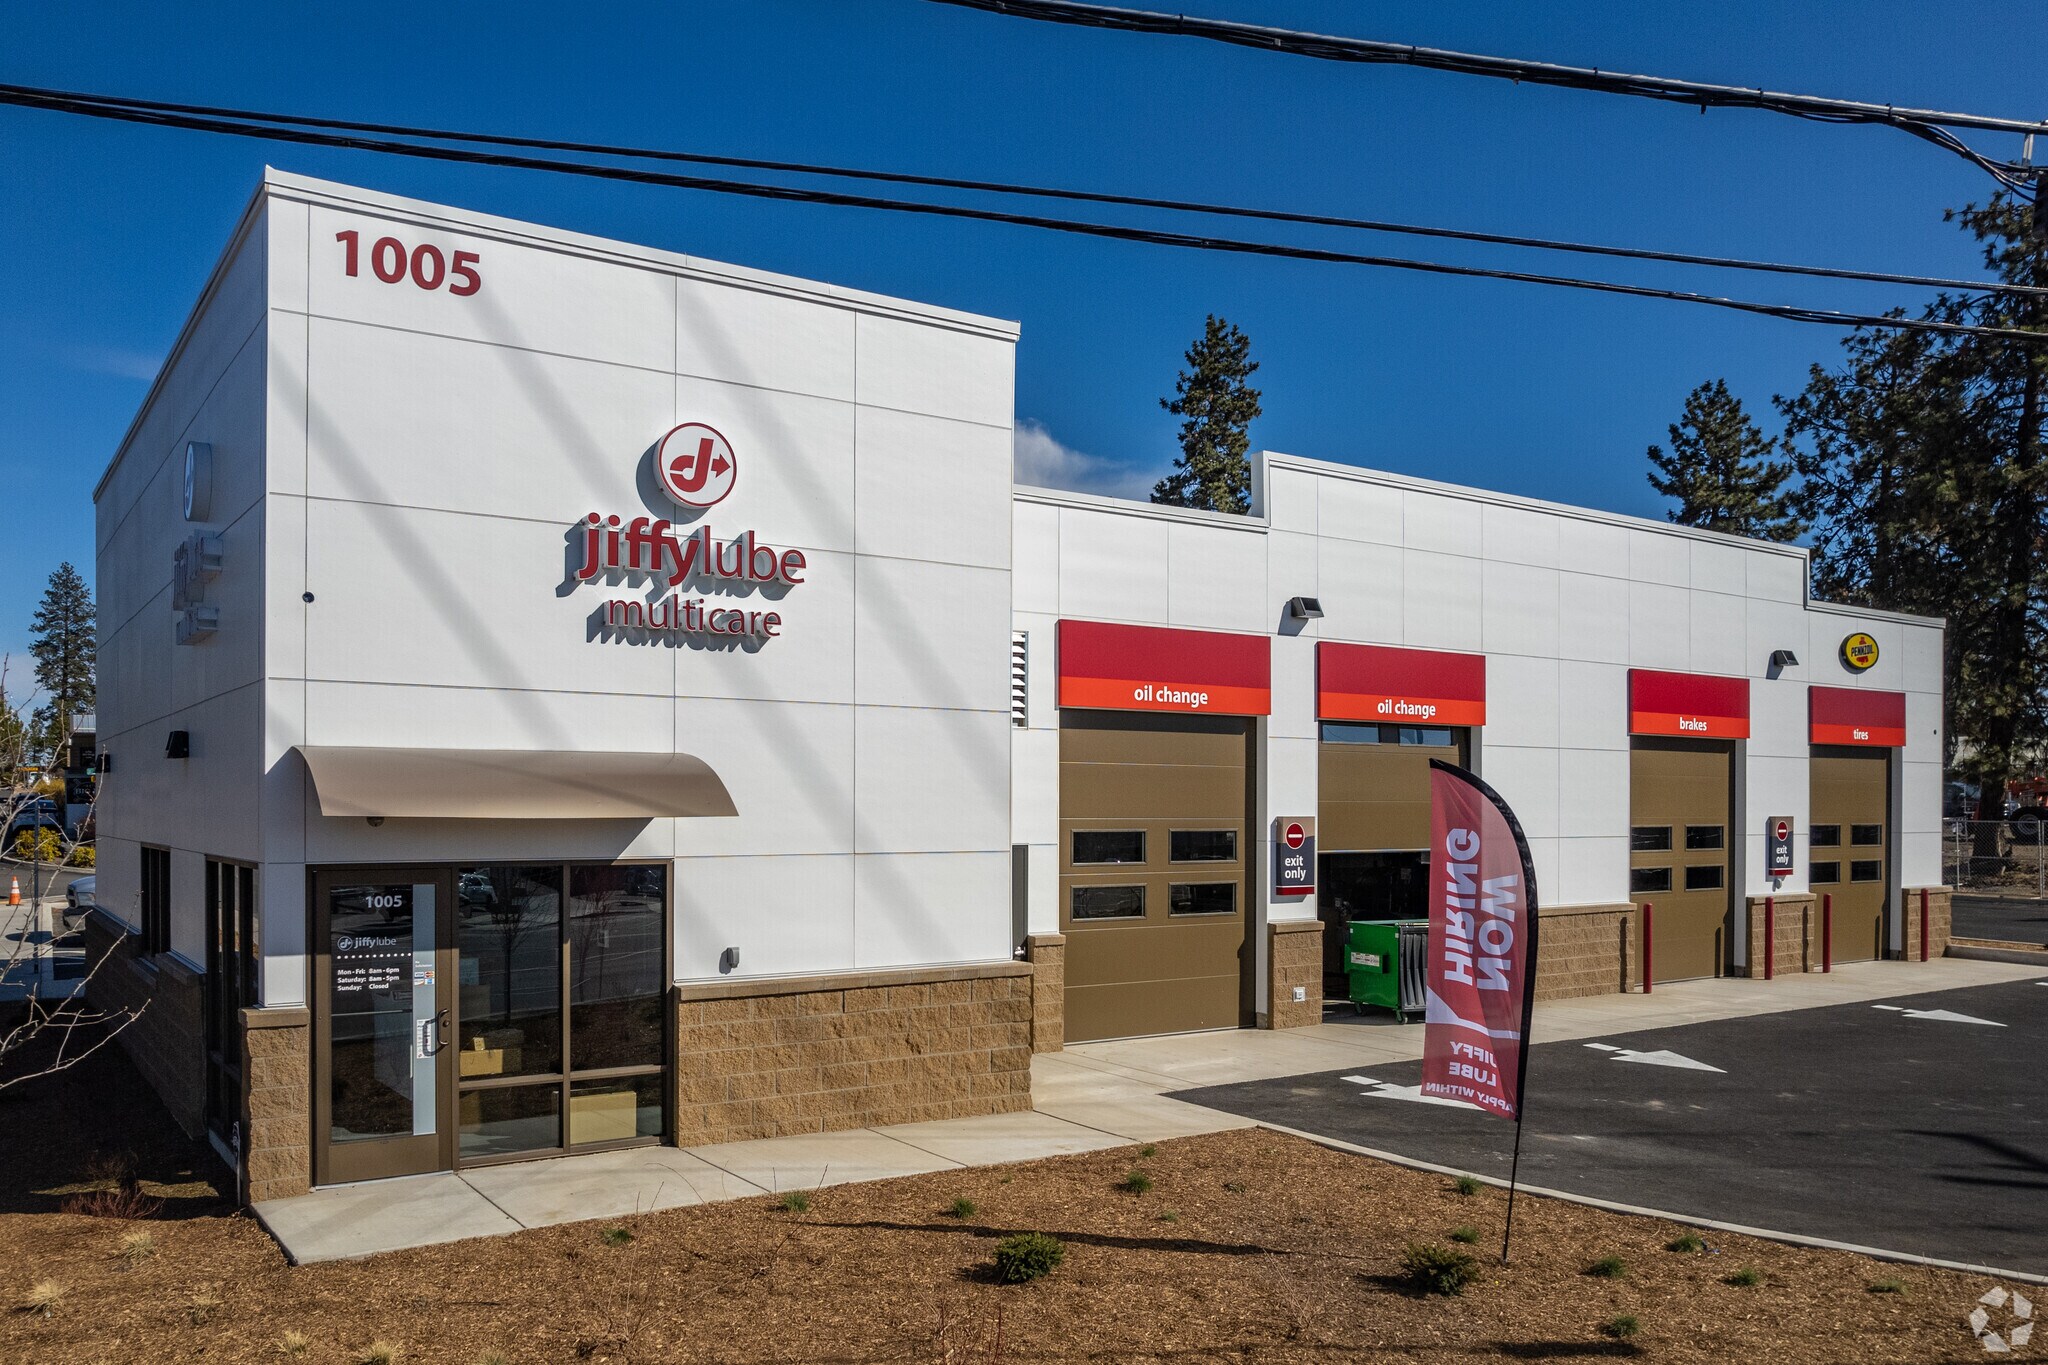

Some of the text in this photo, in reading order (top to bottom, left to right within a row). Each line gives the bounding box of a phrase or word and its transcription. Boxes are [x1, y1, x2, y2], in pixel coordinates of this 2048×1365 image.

[335, 229, 482, 297] 1005
[607, 593, 783, 638] multicare
[1133, 684, 1209, 708] oil change
[1377, 699, 1437, 719] oil change
[1679, 716, 1707, 732] brakes
[1853, 728, 1869, 741] tires
[1776, 845, 1787, 855] exit
[1284, 854, 1304, 867] exit
[1776, 854, 1789, 866] only
[1284, 867, 1307, 882] only
[365, 895, 402, 908] 1005
[337, 982, 390, 992] Sunday: Closed
